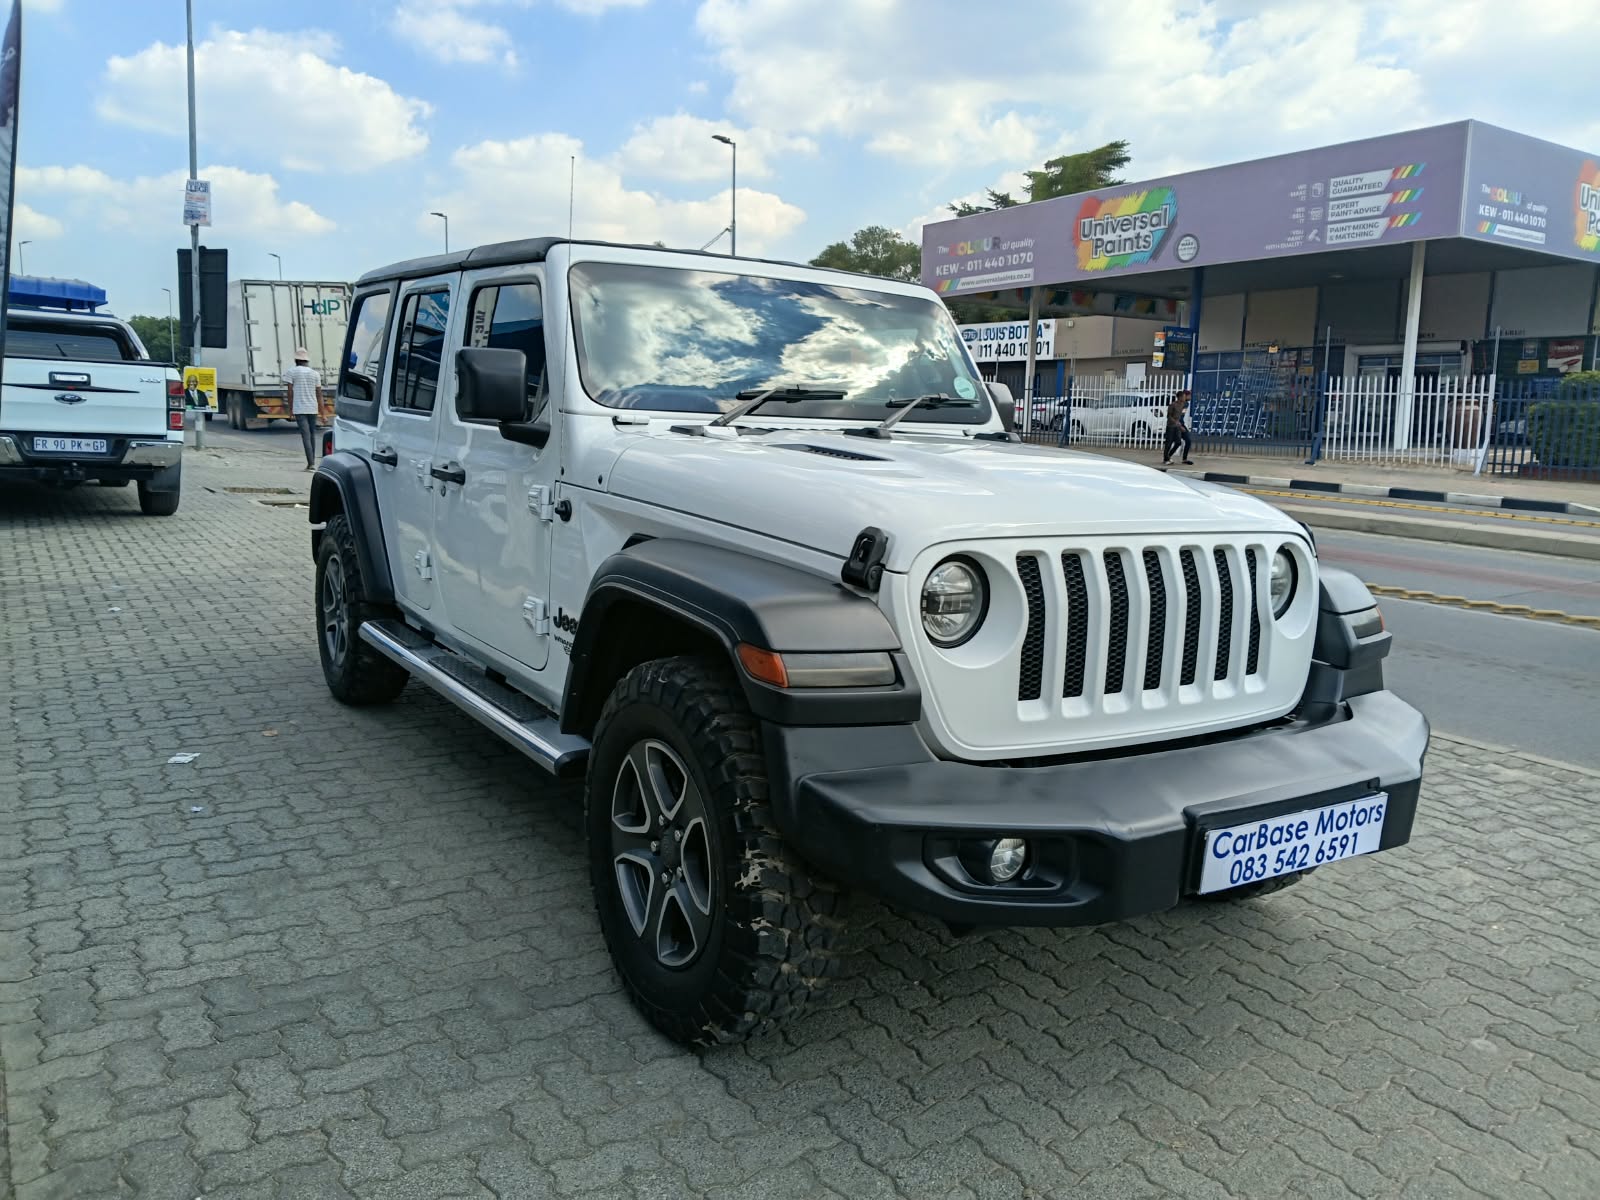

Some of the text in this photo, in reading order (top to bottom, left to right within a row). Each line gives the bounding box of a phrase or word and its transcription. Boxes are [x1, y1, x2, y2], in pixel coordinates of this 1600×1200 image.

[1332, 177, 1364, 188] QUALITY
[1332, 181, 1383, 195] GUARANTEED
[1331, 201, 1360, 211] EXPERT
[1331, 205, 1382, 218] PAINT ADVICE
[1081, 205, 1169, 240] Universal
[1480, 204, 1498, 218] KEW
[1503, 210, 1514, 221] 011
[1515, 213, 1529, 225] 440
[1530, 216, 1547, 228] 1070
[1352, 221, 1380, 232] MIXING
[1011, 237, 1035, 249] quality
[1335, 230, 1375, 241] MATCHING
[1092, 231, 1153, 258] Paints
[936, 263, 960, 277] KEW
[967, 260, 982, 271] 011
[984, 256, 1005, 269] 440
[1007, 252, 1034, 266] 1070
[979, 326, 1007, 341] LOUIS
[1009, 324, 1043, 340] BOTA
[994, 343, 1016, 357] 440
[1019, 341, 1050, 356] 100/1
[35, 439, 105, 451] FR 90 PK GP
[553, 607, 579, 635] Jee
[1213, 803, 1384, 858] CarBase Motors
[1230, 832, 1359, 884] 083 542 6591
